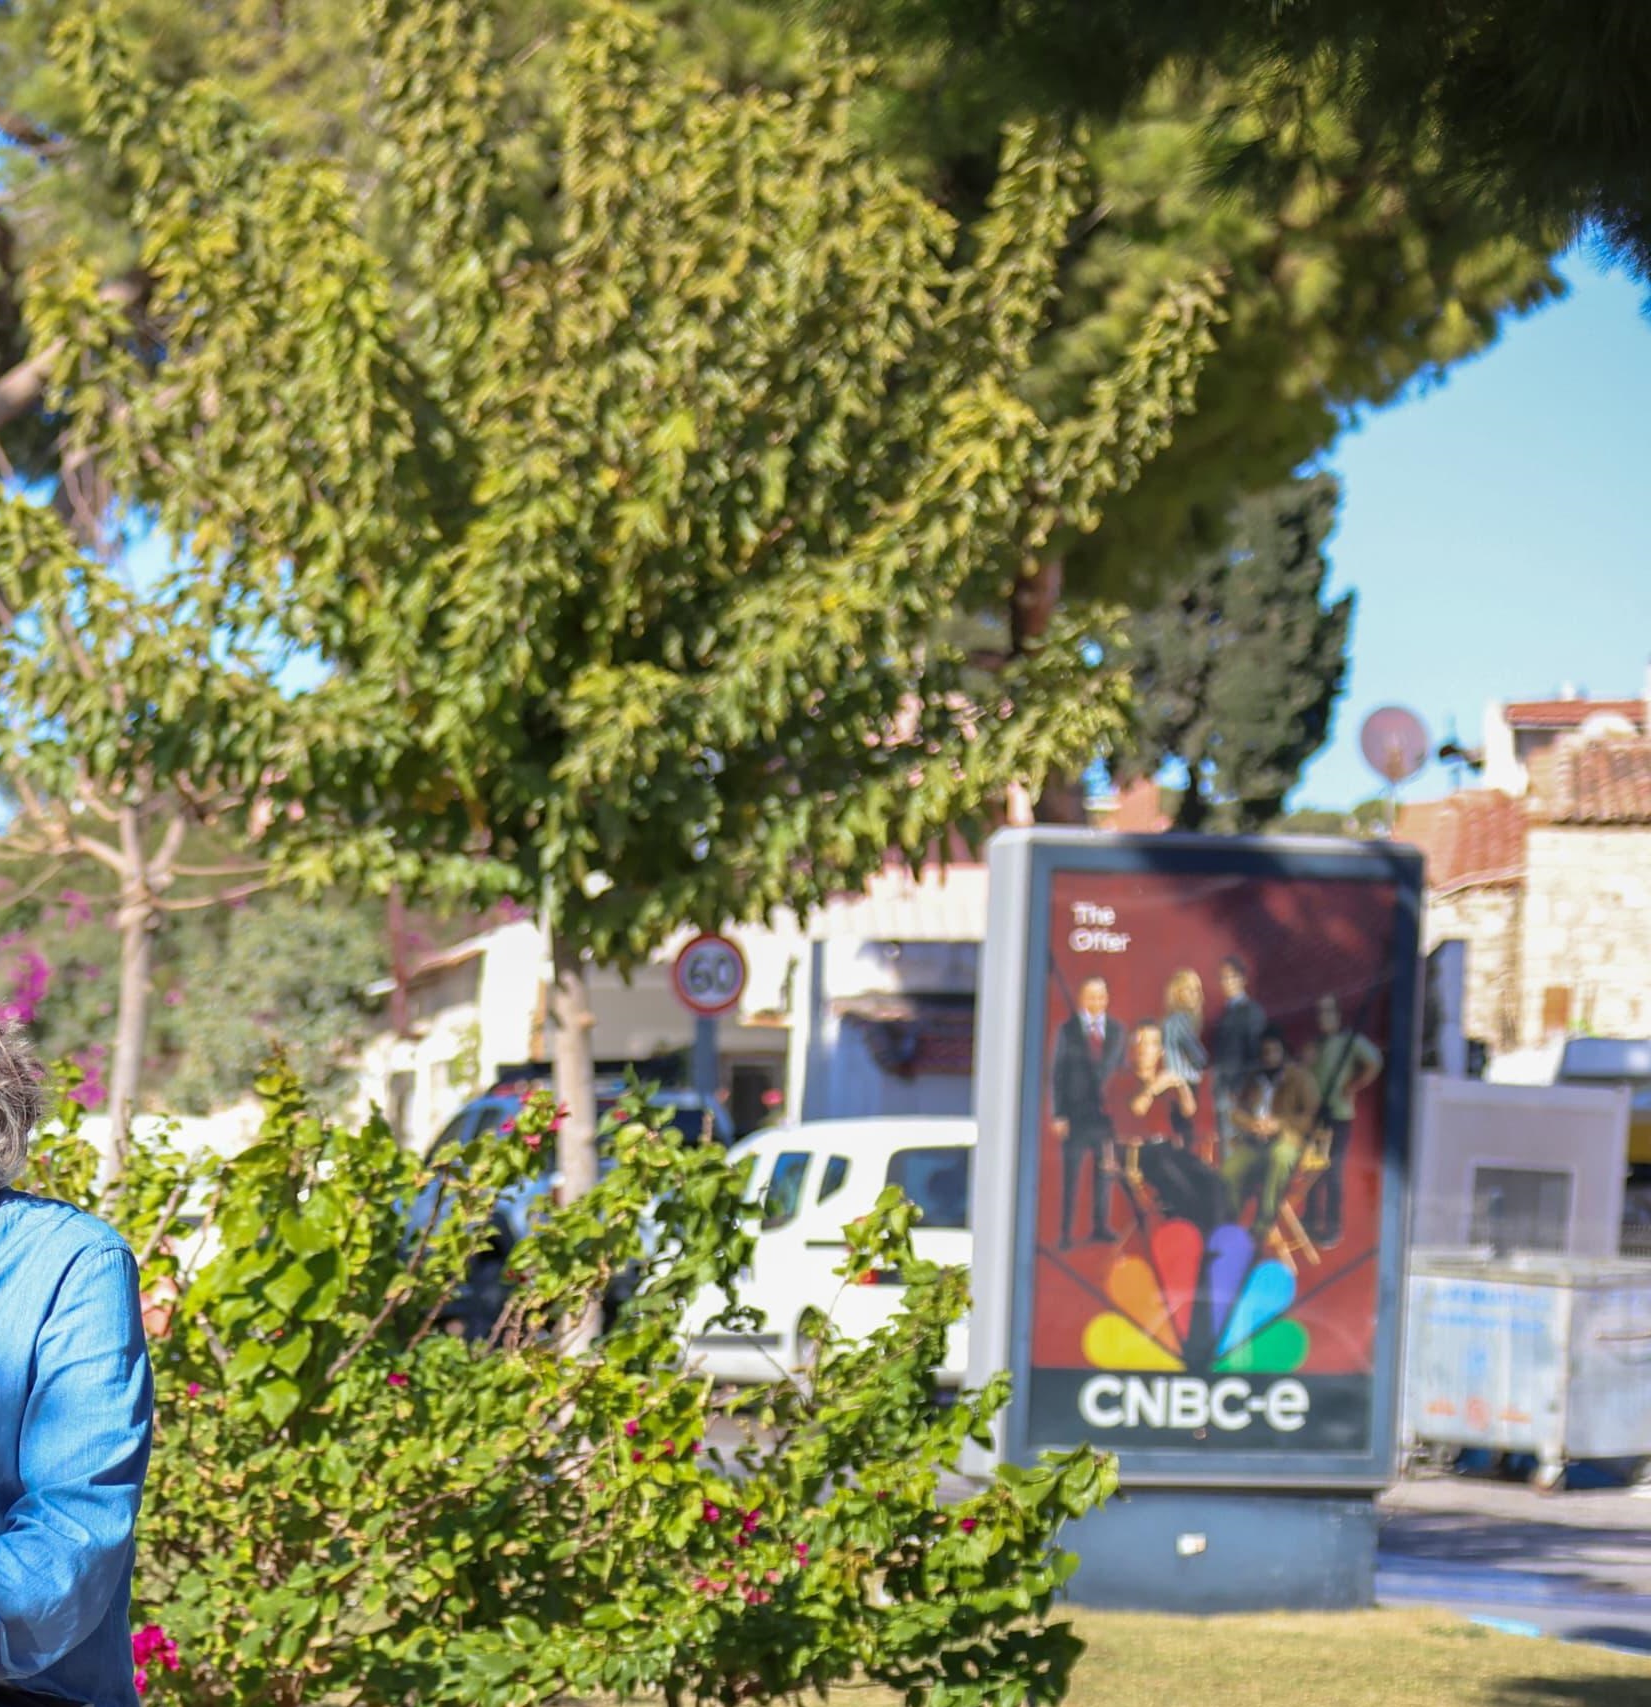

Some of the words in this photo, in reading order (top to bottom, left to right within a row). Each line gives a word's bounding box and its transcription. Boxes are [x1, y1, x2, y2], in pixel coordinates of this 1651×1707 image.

[1072, 902, 1116, 927] The
[1070, 928, 1130, 953] Offer
[689, 952, 734, 994] 60
[1079, 1376, 1309, 1432] CNBC-e
